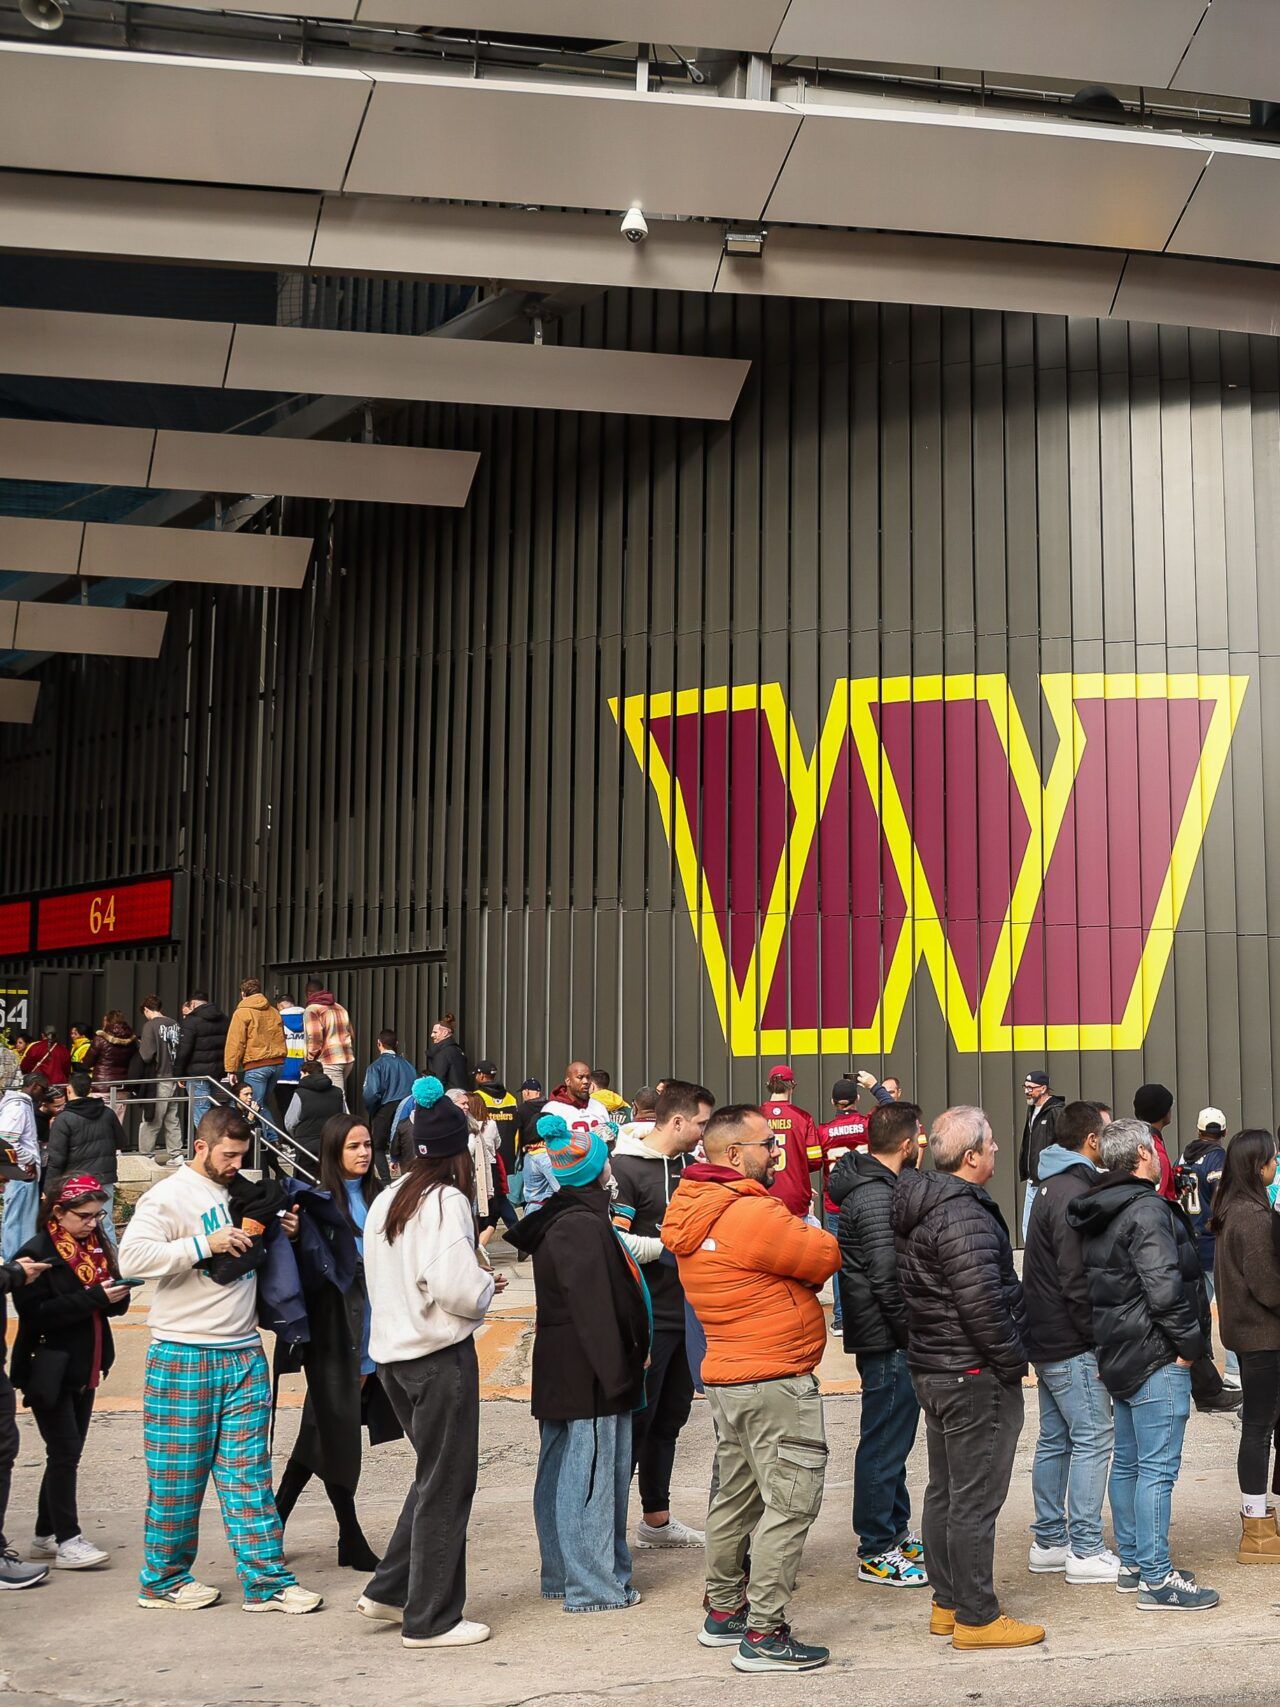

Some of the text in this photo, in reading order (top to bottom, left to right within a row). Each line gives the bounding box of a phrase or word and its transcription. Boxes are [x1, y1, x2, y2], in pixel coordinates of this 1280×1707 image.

[89, 895, 116, 934] 64
[488, 1110, 514, 1121] teelers
[768, 1118, 792, 1130] ANIELS
[828, 1123, 864, 1137] SANDERS
[201, 1203, 230, 1235] MI
